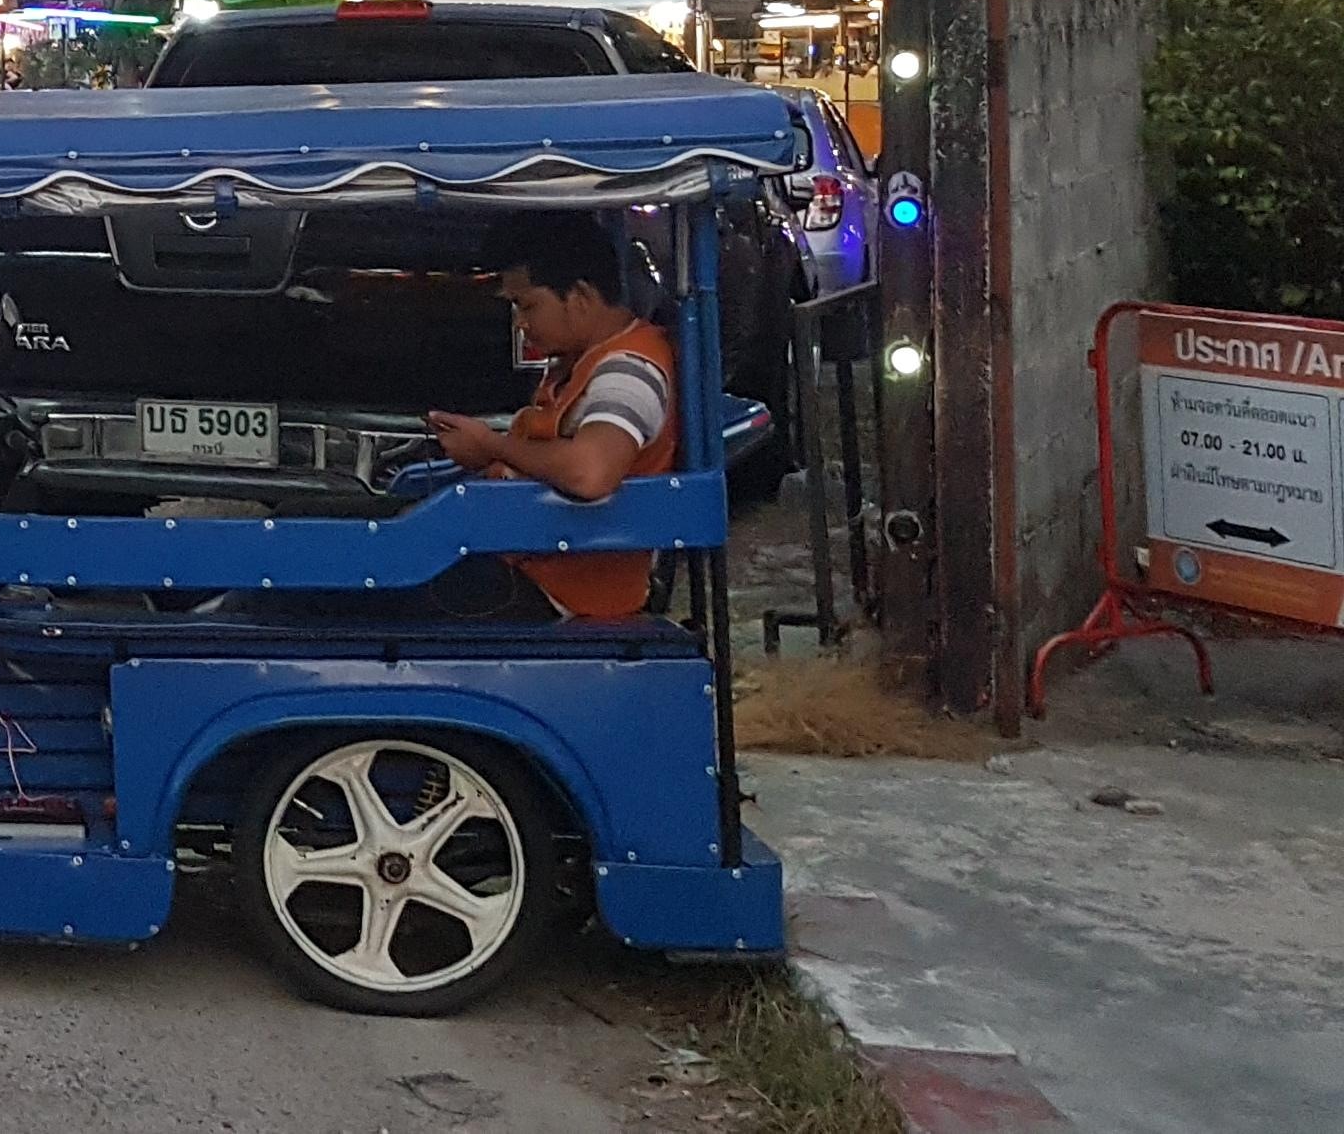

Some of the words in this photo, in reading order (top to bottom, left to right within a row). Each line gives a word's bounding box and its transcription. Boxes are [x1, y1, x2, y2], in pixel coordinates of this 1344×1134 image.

[1175, 328, 1281, 372] ประกาศ
[146, 406, 188, 434] บธ
[198, 408, 268, 438] 5903
[1180, 429, 1223, 451] 07.00
[1242, 440, 1286, 461] 21.00
[1293, 450, 1308, 464] น.
